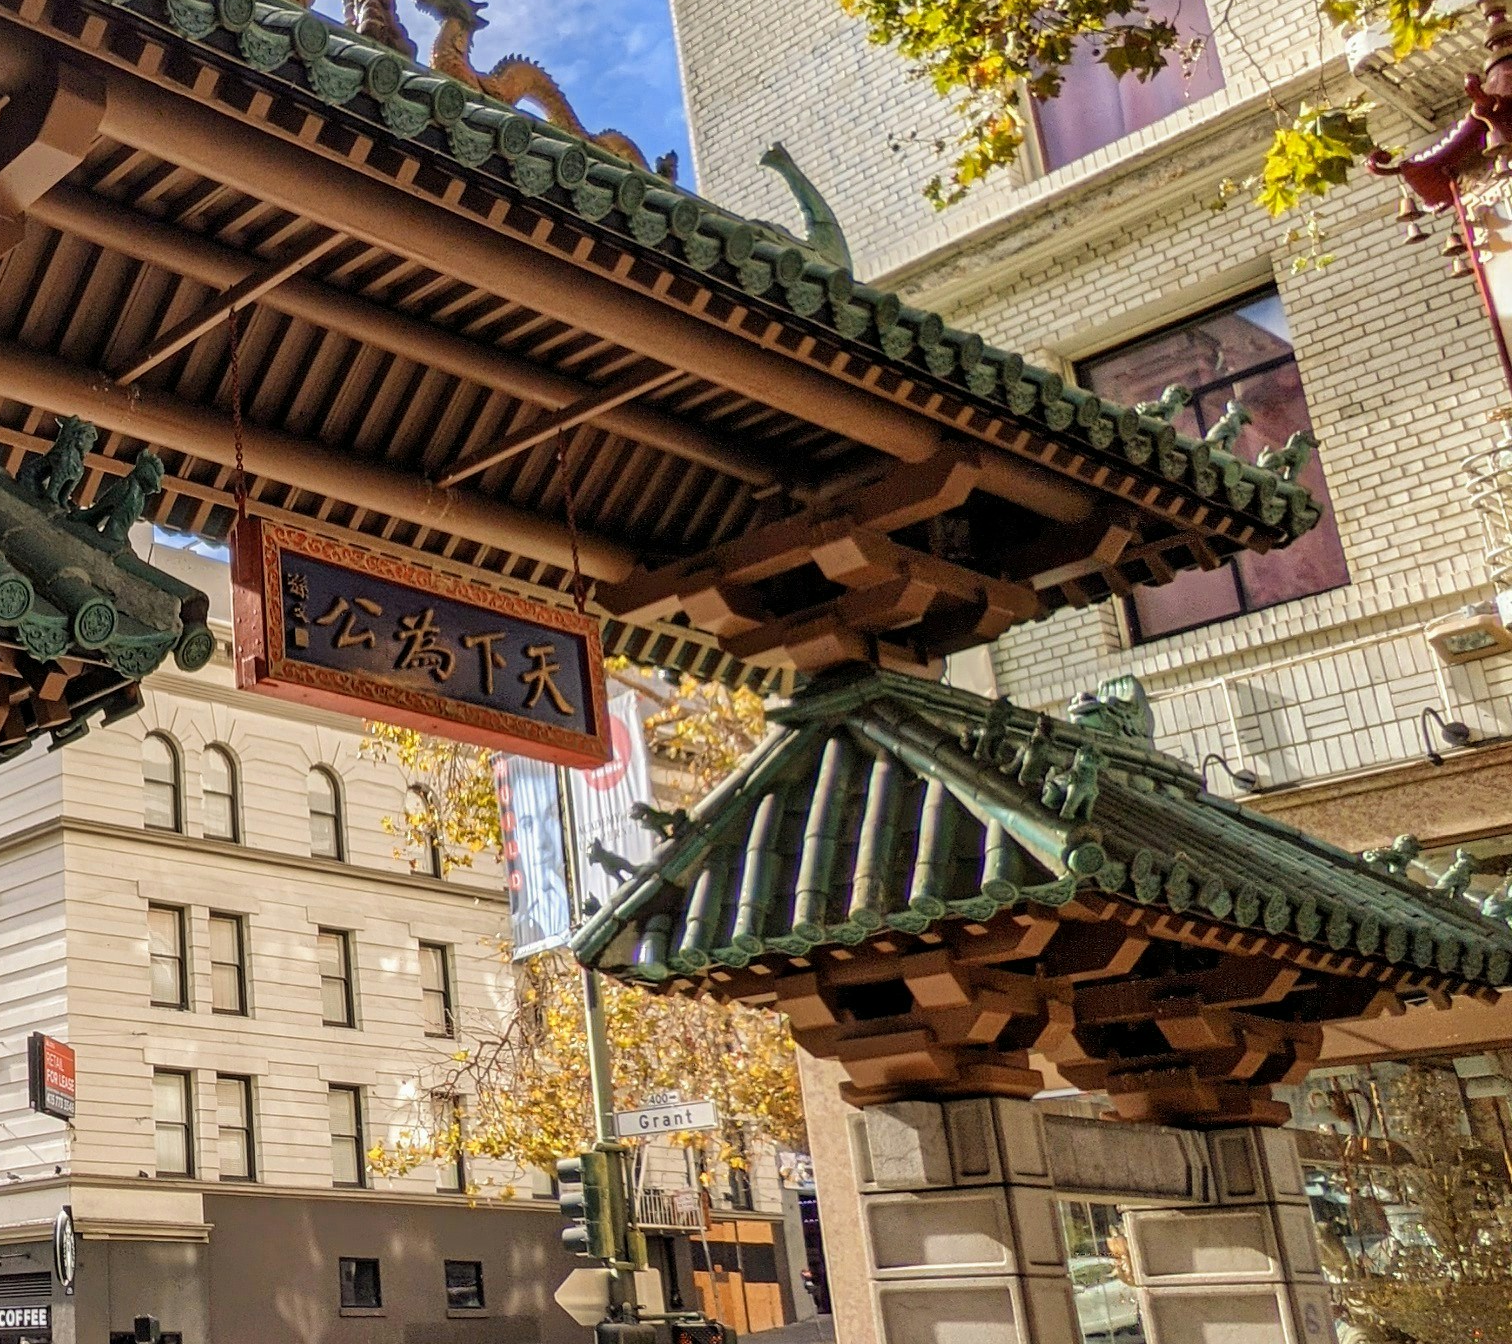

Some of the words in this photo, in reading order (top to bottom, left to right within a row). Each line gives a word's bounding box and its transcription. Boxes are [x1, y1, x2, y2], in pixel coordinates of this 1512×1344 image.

[46, 1068, 58, 1085] FOR
[59, 1074, 75, 1092] LEASE
[648, 1093, 669, 1105] 400
[639, 1109, 693, 1130] Grant
